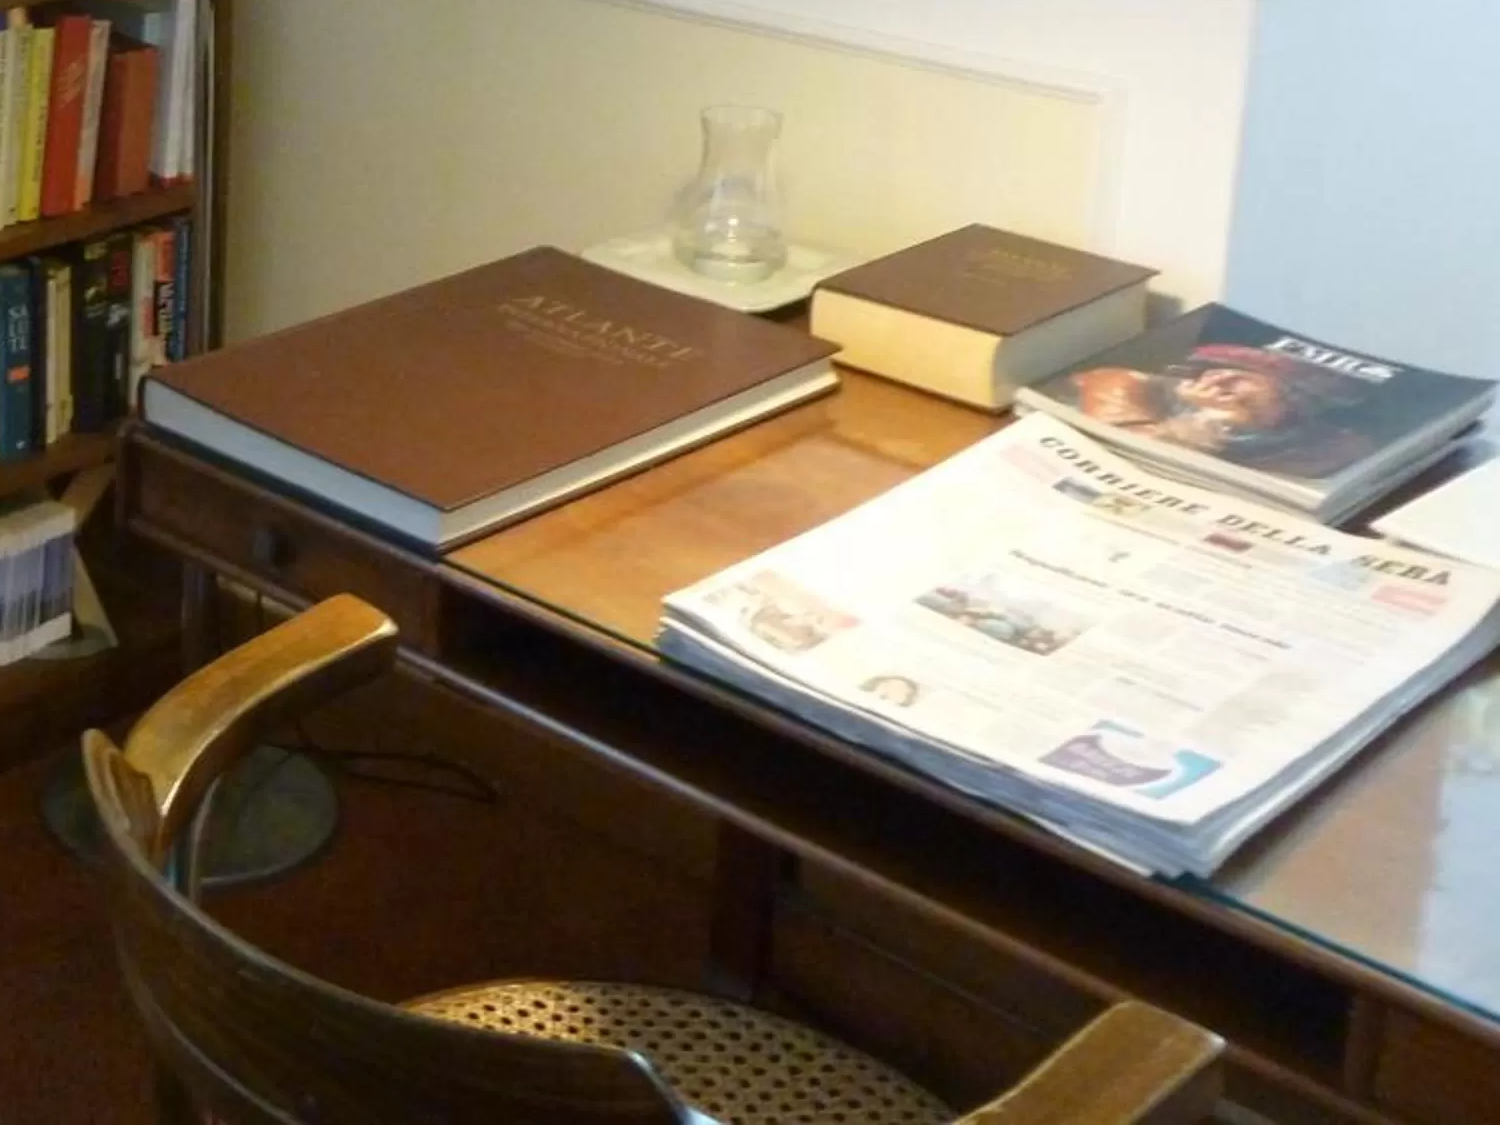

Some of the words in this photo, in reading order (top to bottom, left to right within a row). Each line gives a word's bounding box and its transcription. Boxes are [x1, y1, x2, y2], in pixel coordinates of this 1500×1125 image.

[1039, 436, 1211, 515] CORRIERE
[1215, 513, 1332, 555] DELLA
[1357, 554, 1453, 585] SERA
